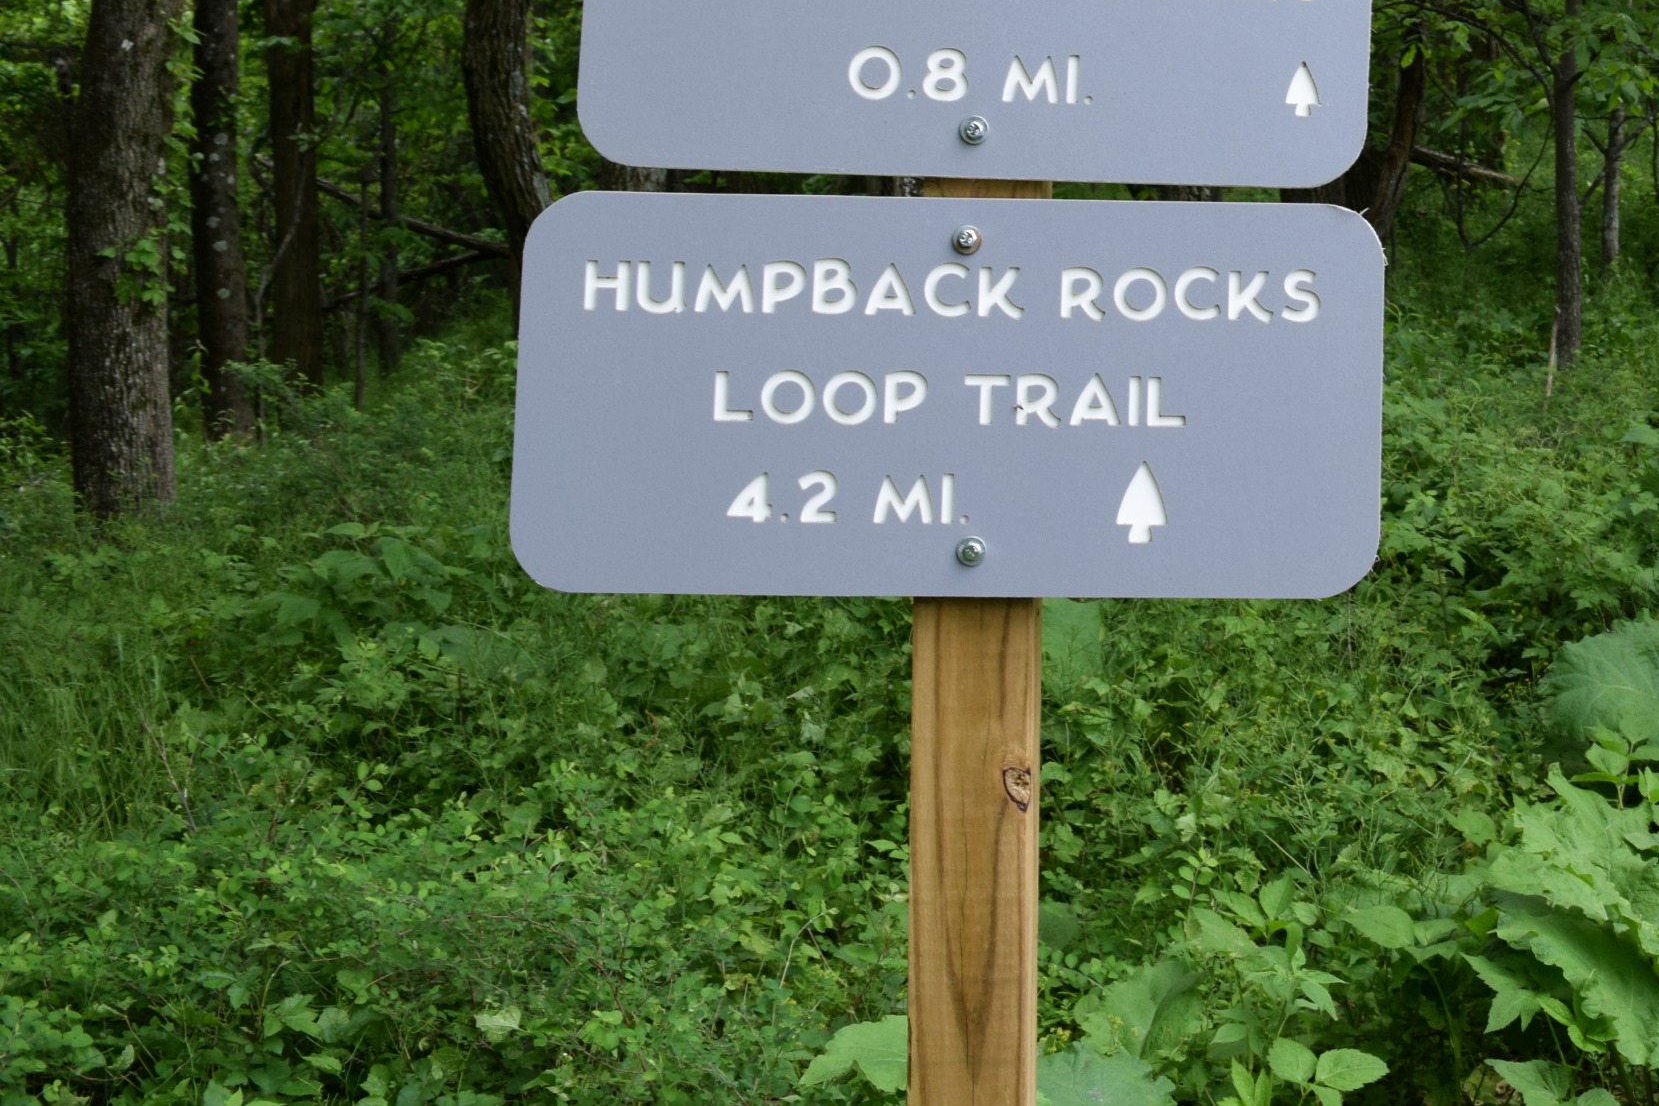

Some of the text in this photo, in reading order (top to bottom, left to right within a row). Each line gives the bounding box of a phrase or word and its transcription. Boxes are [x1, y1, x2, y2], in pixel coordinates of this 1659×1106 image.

[848, 45, 1094, 105] 0.8 MI.
[583, 257, 1321, 323] HUMPBACK ROCKS
[713, 370, 1187, 429] LOOP TRAIL
[727, 470, 970, 525] 4.2 MI.
